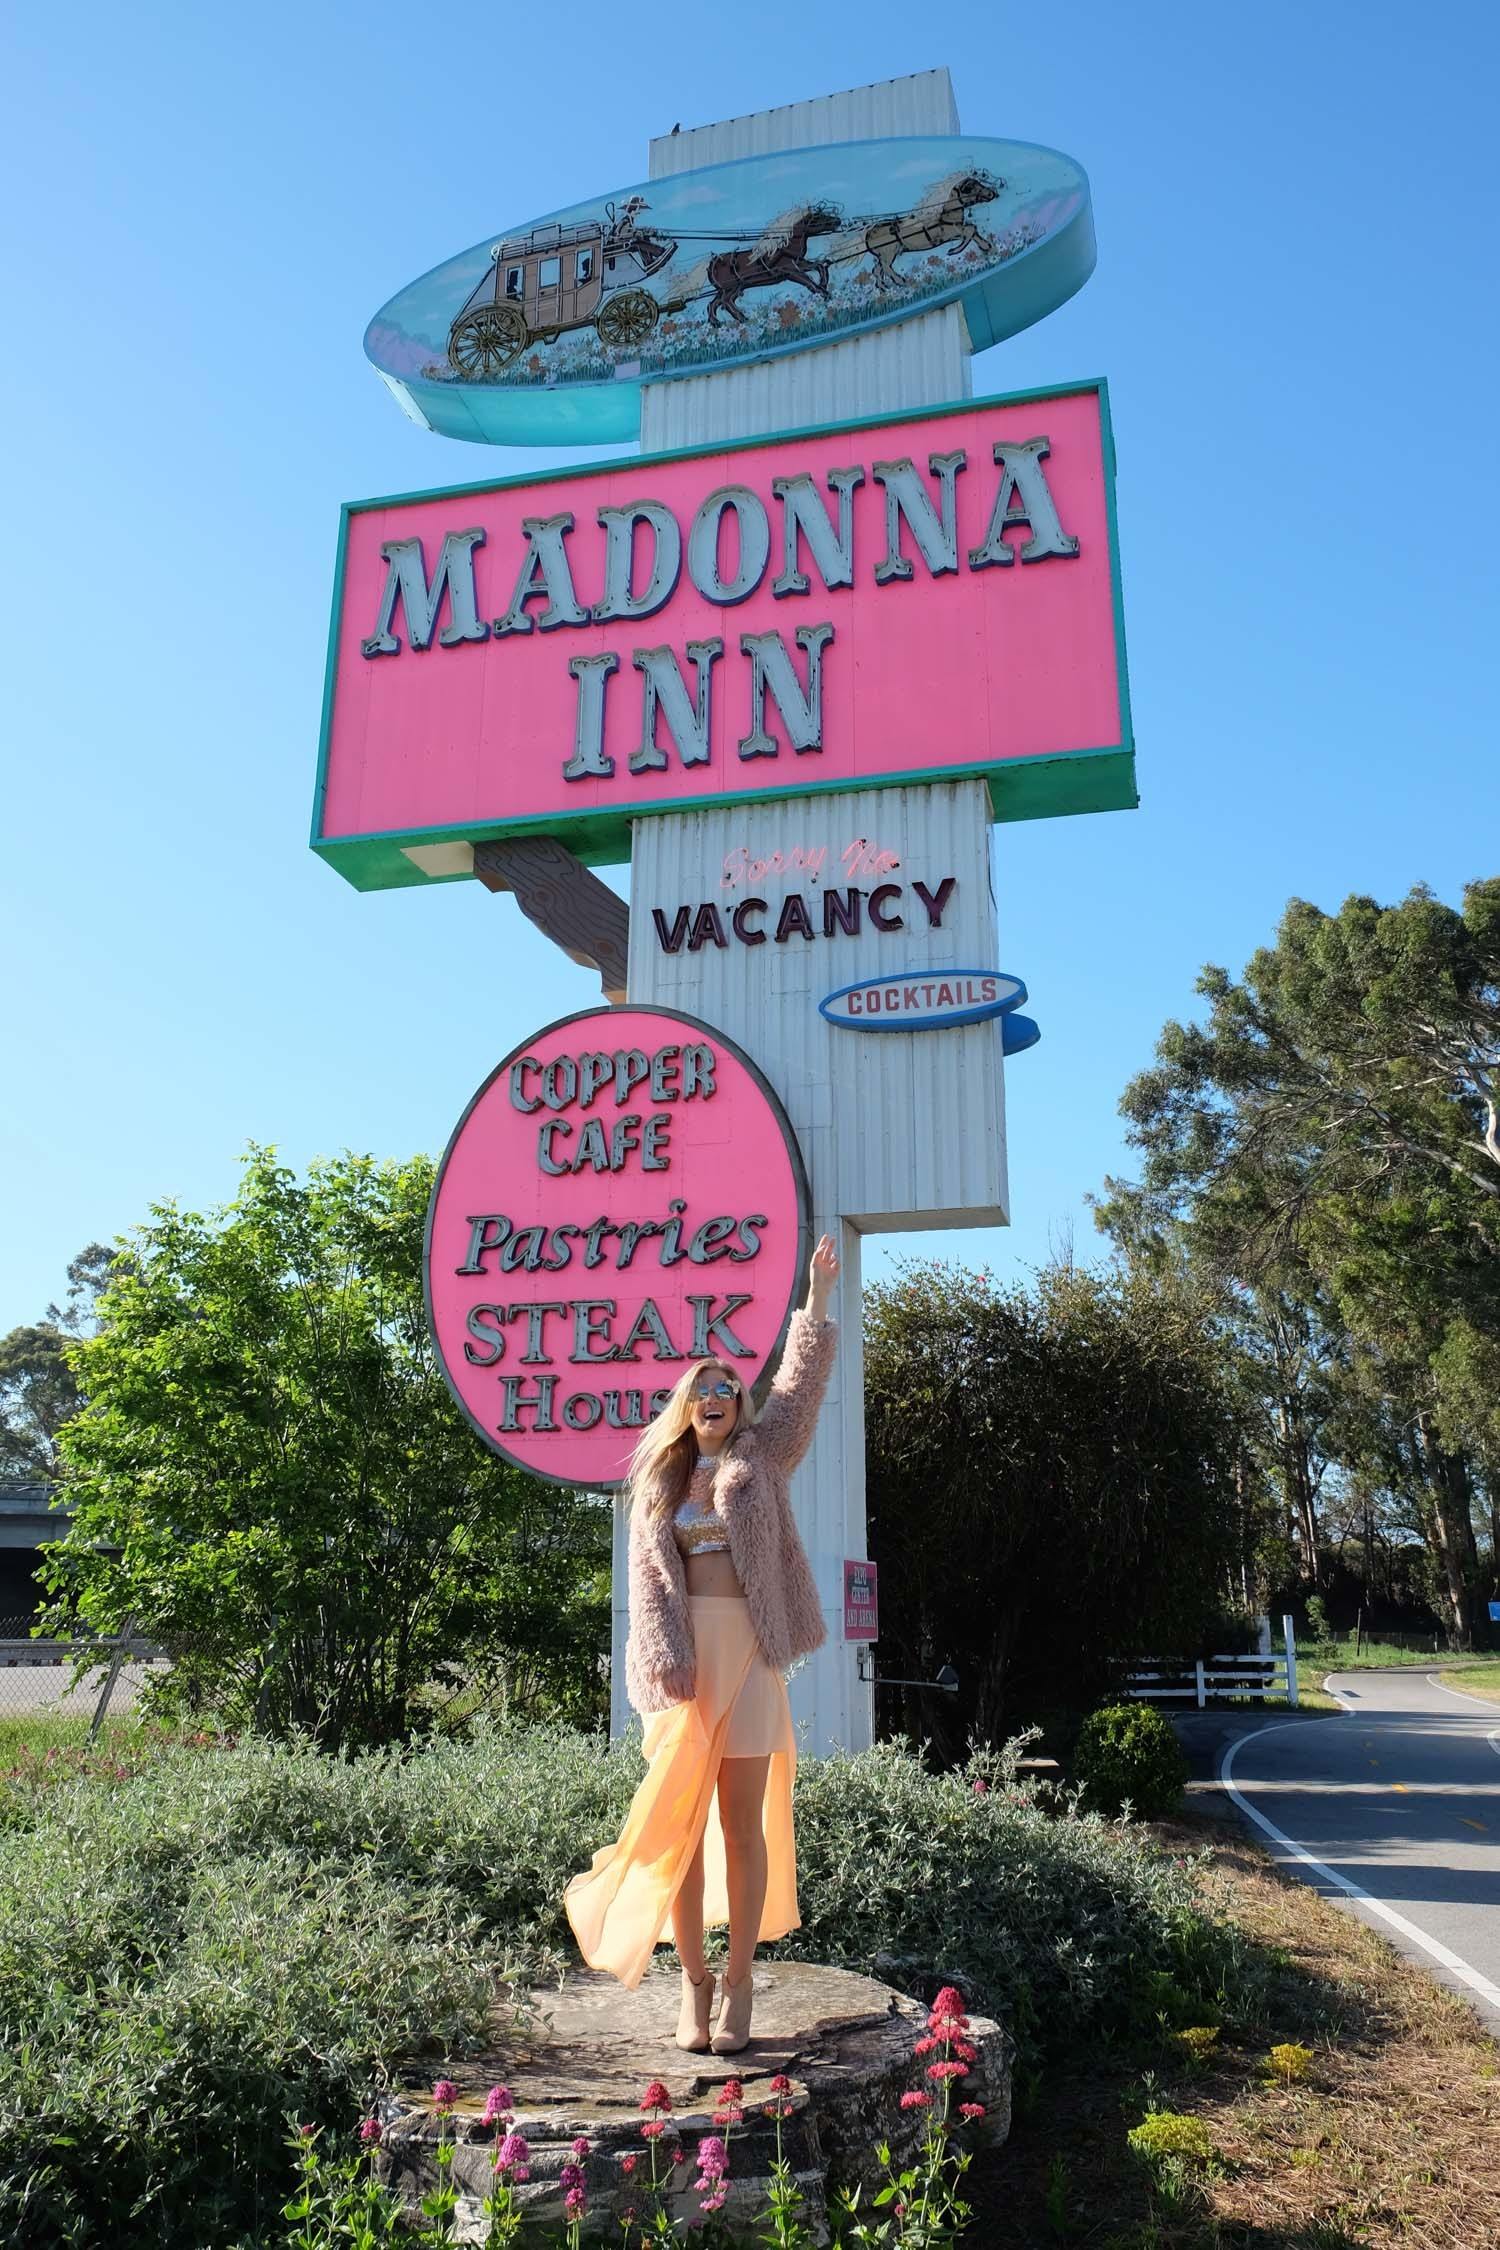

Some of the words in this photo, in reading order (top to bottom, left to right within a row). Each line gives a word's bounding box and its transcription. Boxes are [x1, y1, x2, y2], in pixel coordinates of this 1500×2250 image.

[361, 436, 1081, 660] MADONNA
[562, 621, 835, 782] INN
[720, 846, 827, 888] Sorry
[841, 838, 900, 879] No
[652, 877, 956, 954] VACANCY
[847, 978, 997, 1016] COCKTAILS
[510, 1042, 716, 1113] COPPER
[538, 1113, 671, 1177] CAFE
[455, 1198, 768, 1276] Pastries
[464, 1294, 757, 1367] STEAK
